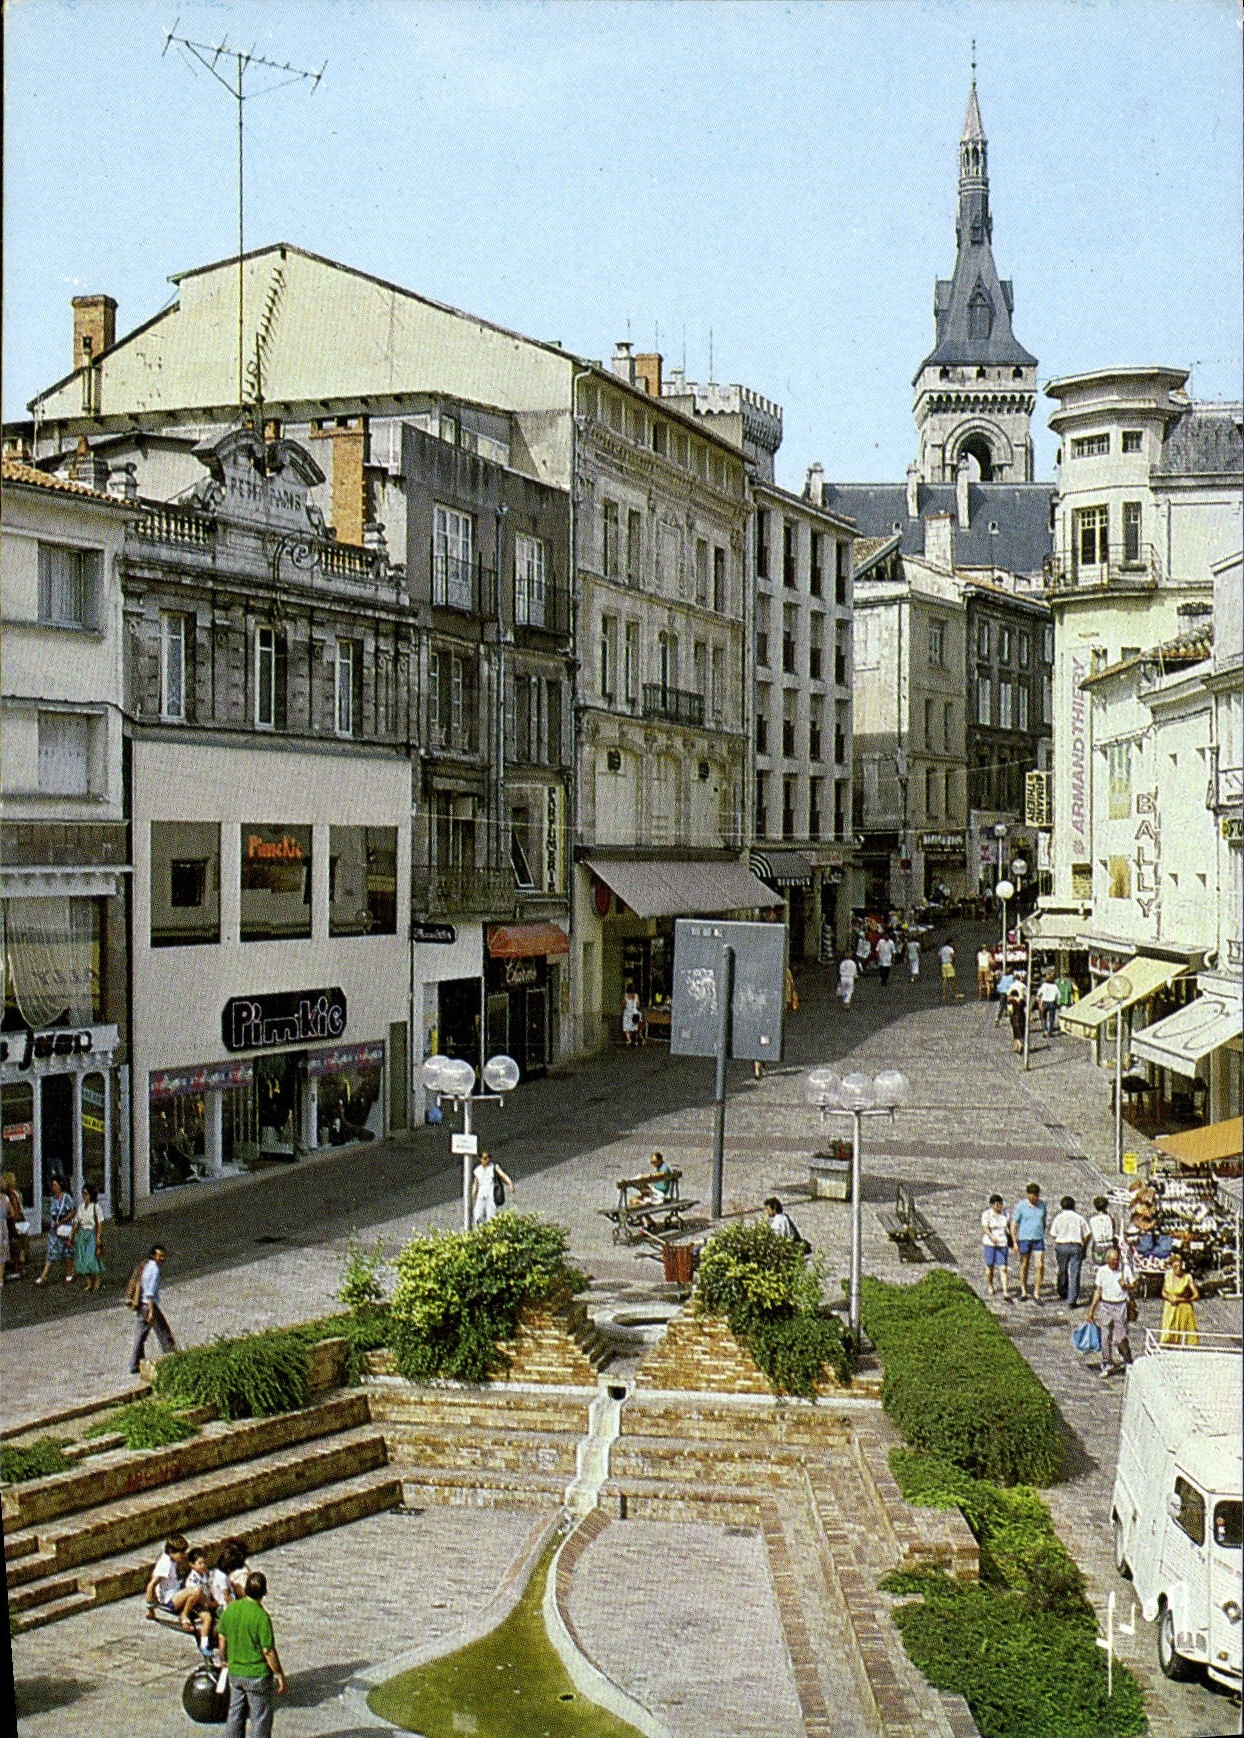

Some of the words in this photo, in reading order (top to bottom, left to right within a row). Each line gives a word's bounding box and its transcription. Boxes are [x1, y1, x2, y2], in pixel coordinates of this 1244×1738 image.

[1072, 738, 1085, 836] ARMAND
[1134, 793, 1155, 919] BALLY
[232, 995, 344, 1048] Pimkie
